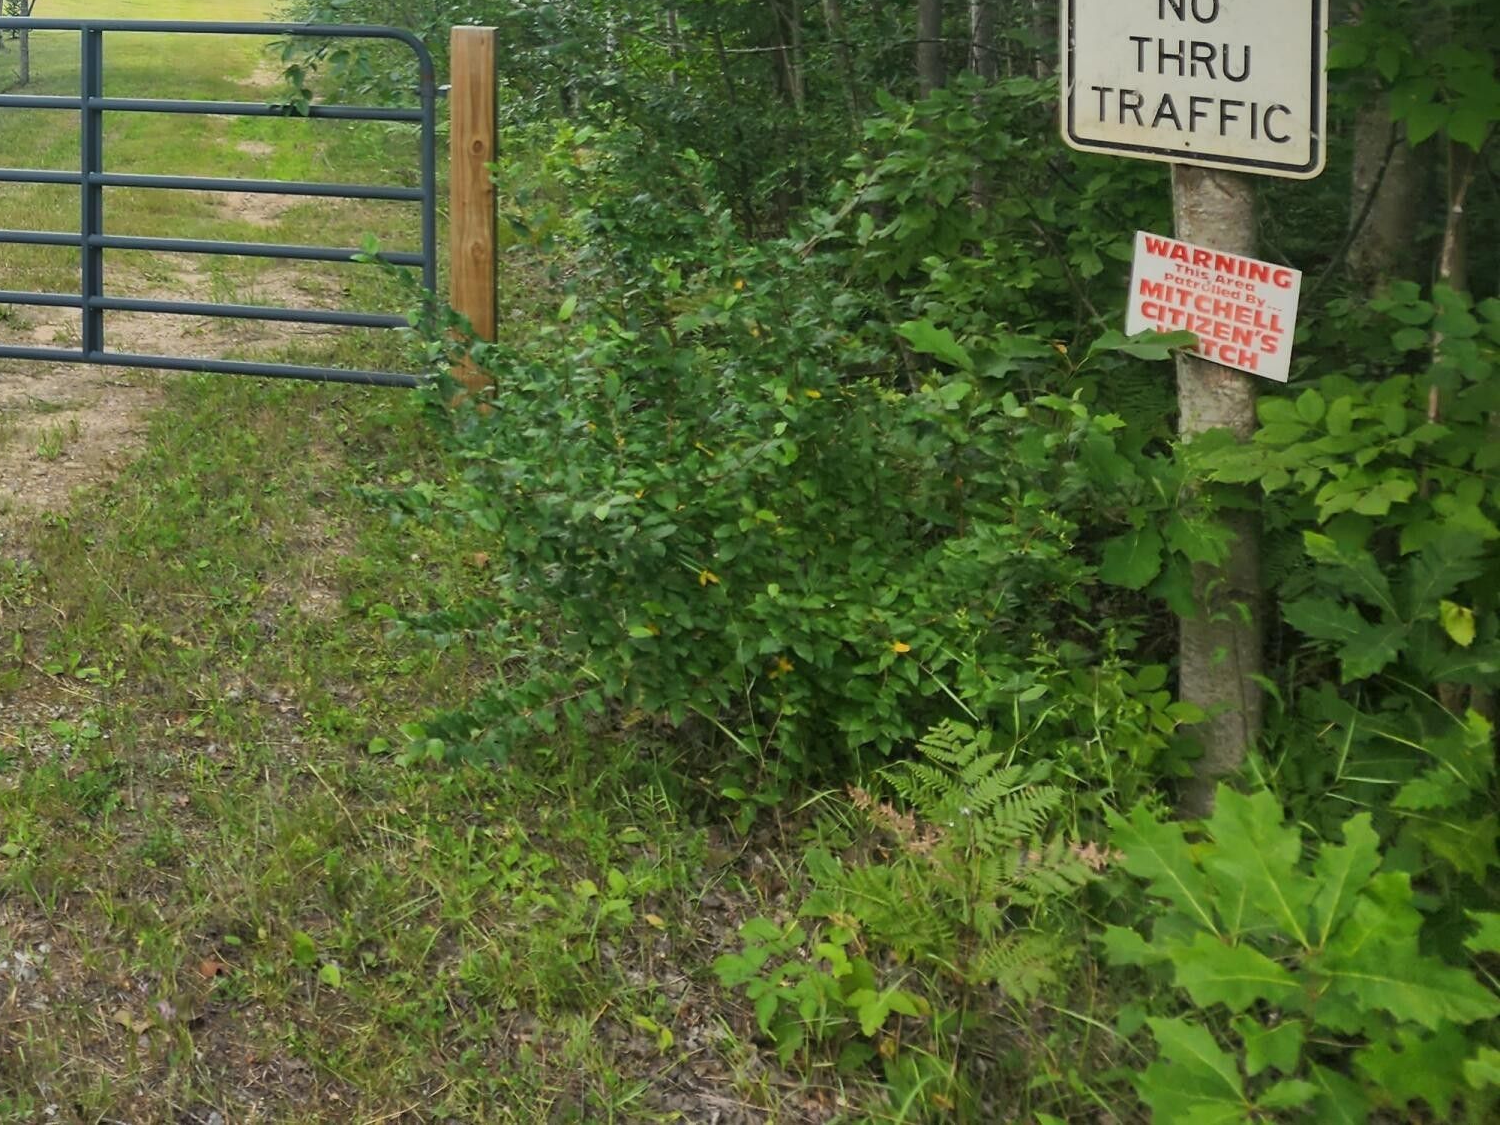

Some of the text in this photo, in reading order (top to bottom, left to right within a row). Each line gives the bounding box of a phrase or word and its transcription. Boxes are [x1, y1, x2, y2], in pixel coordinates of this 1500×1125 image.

[1129, 35, 1251, 82] THRU
[1091, 85, 1292, 144] TRAFFIC
[1145, 236, 1293, 289] WARNING
[1175, 264, 1256, 292] This Area
[1139, 278, 1285, 334] MITCHELL
[1141, 300, 1279, 355] CITIZEN'S
[1156, 325, 1260, 370] TCH
